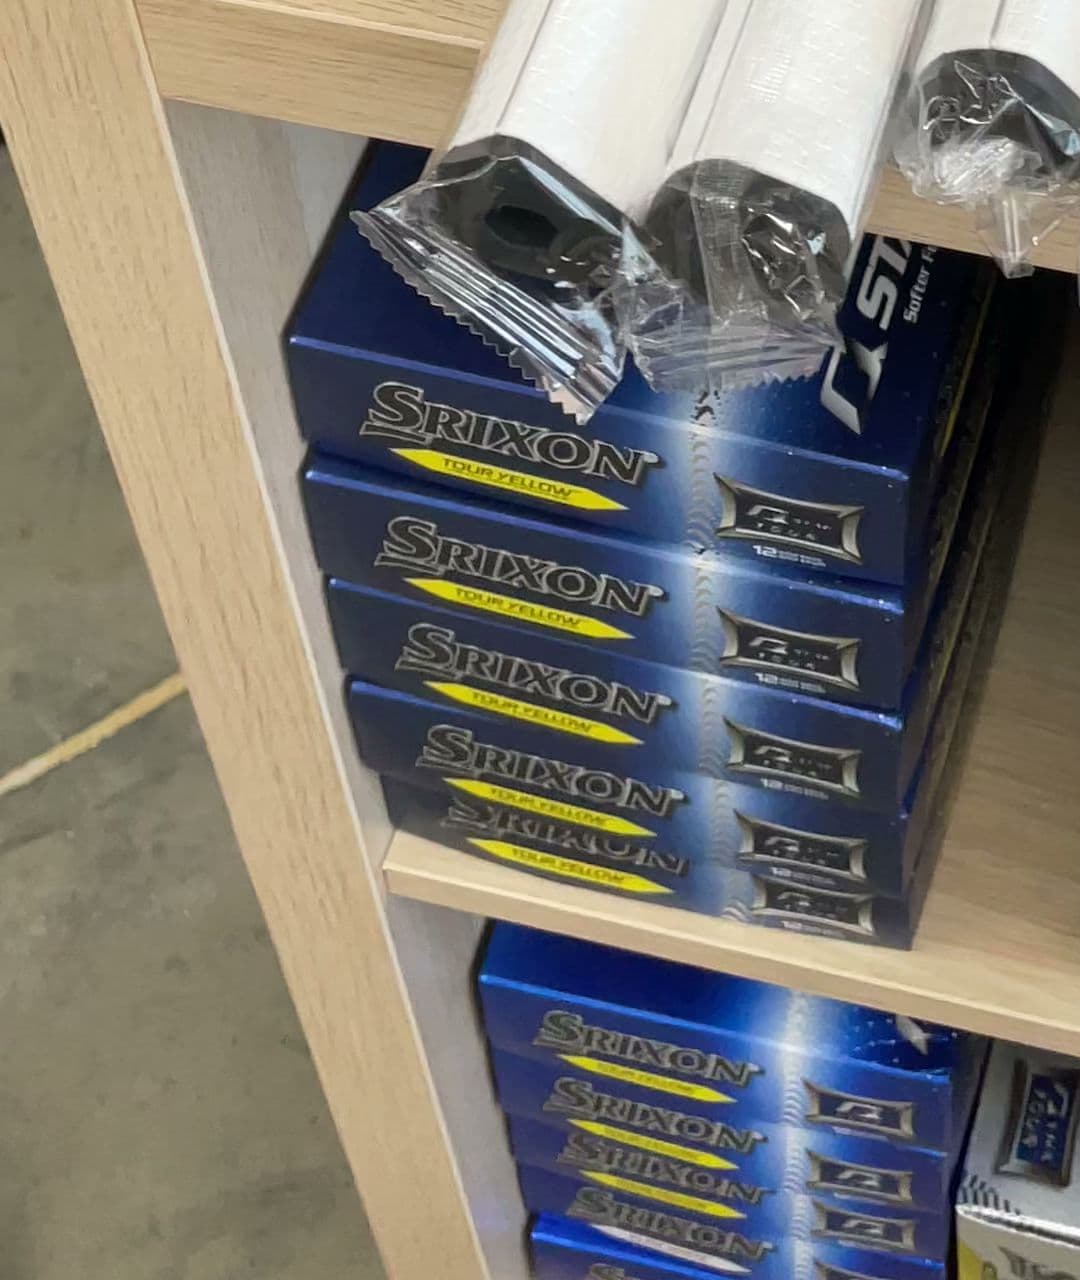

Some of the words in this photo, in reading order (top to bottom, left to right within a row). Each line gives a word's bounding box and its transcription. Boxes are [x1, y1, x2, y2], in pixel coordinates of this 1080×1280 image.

[360, 381, 652, 485] SRIXON
[441, 456, 495, 480] TOUR
[498, 471, 573, 498] YELLOW
[374, 516, 656, 616] SRIXON
[752, 544, 778, 558] 12
[455, 586, 504, 608] TOUR
[507, 600, 581, 627] YELLOW
[395, 623, 664, 724] SRIXON
[415, 724, 678, 816] SRIXON
[533, 1010, 754, 1087] SRIXON
[543, 1077, 758, 1155] SRIXON
[566, 1187, 767, 1262] SRIXON
